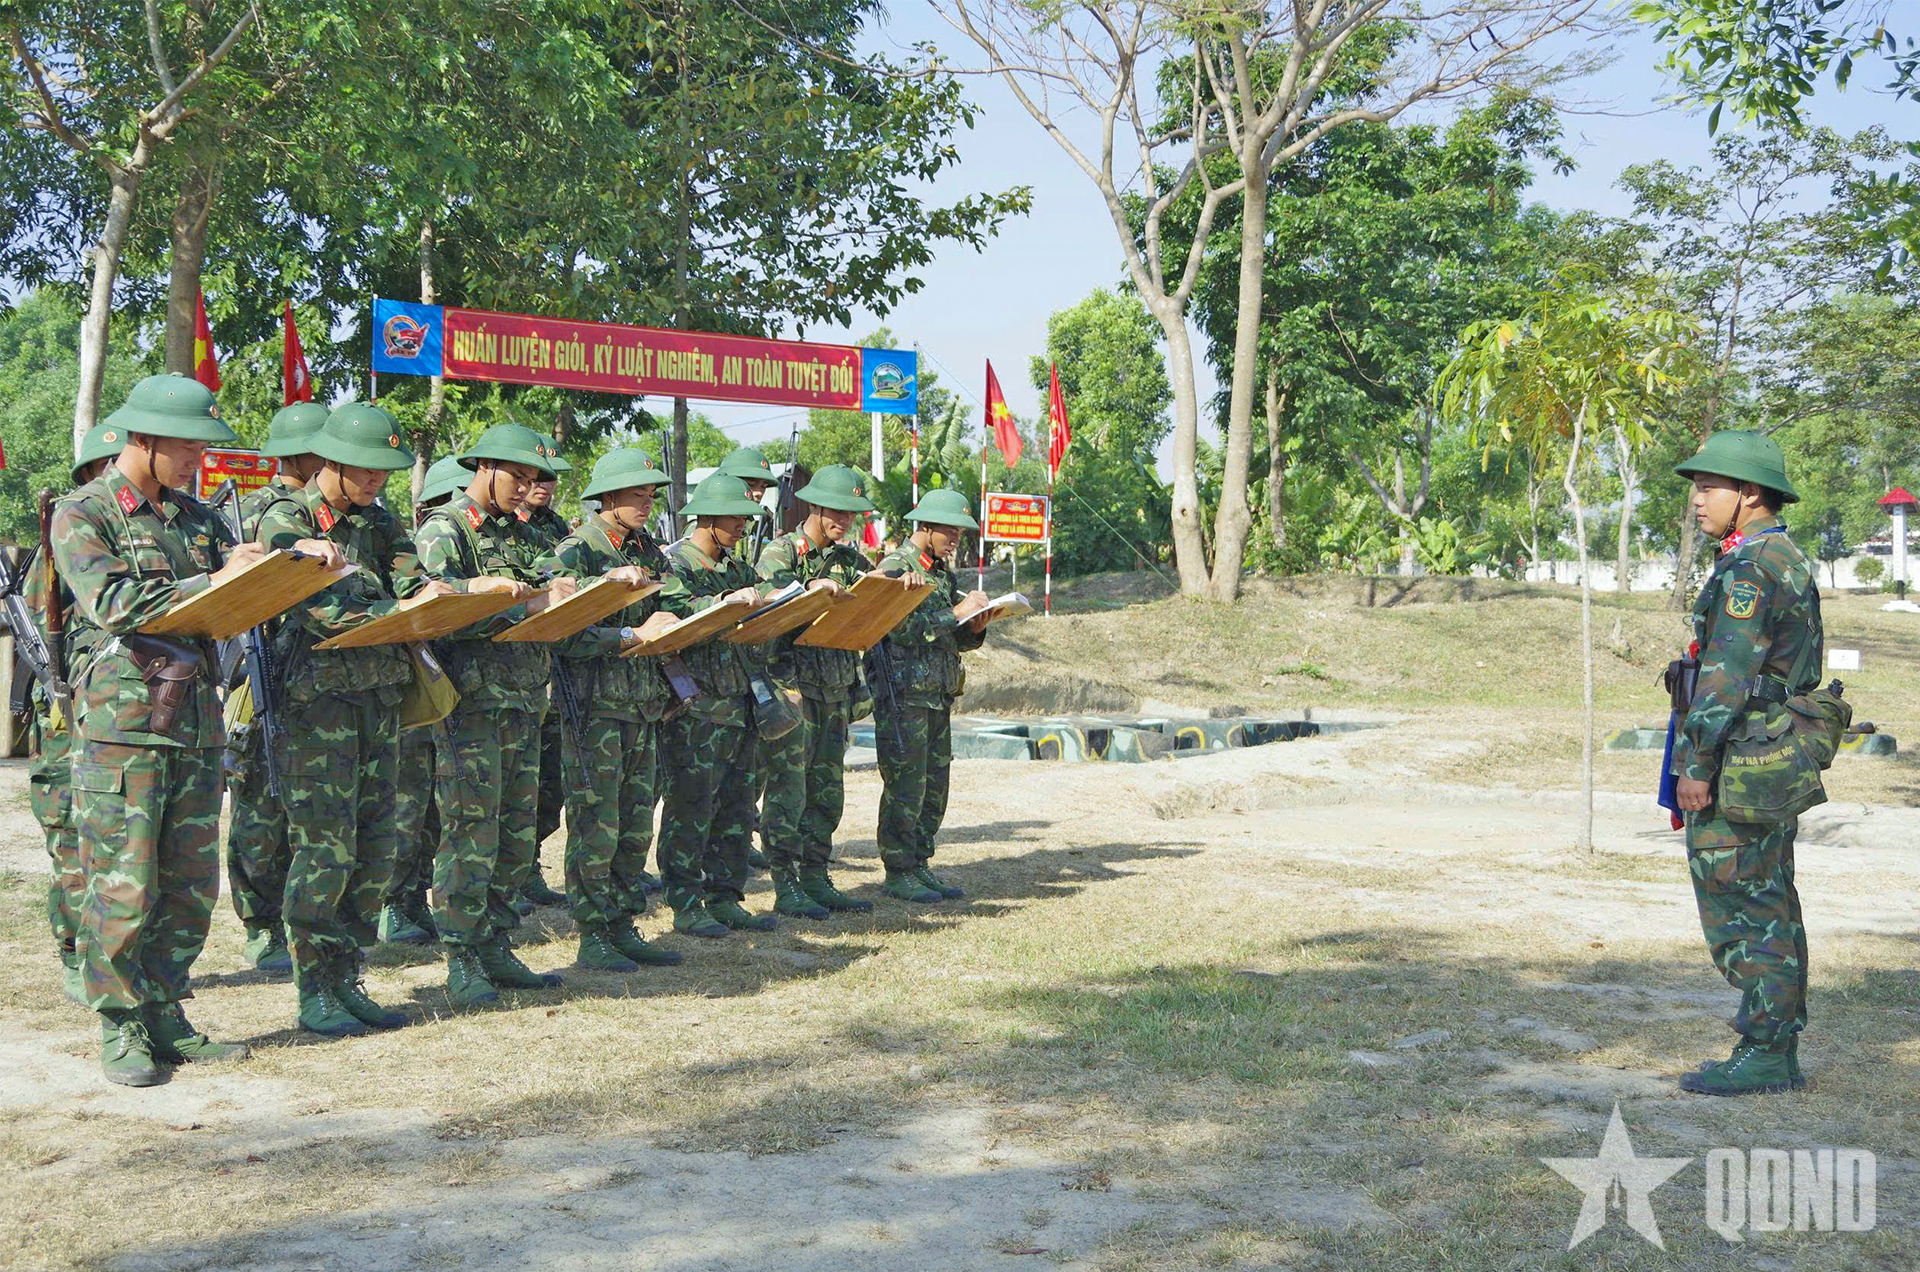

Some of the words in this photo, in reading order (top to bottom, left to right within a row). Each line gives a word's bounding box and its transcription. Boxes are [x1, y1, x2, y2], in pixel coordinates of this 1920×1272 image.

[453, 323, 497, 364] HUẤN
[501, 331, 550, 374] LUYỆN
[555, 331, 589, 375] GIỎI,
[594, 335, 613, 374] KỶ
[617, 342, 652, 383] LUẬT
[657, 347, 718, 387] NGHIÊM,
[722, 355, 742, 385] AN
[746, 353, 782, 389] TOÀN
[786, 357, 828, 398] TUYỆT
[830, 355, 853, 394] ĐỐI
